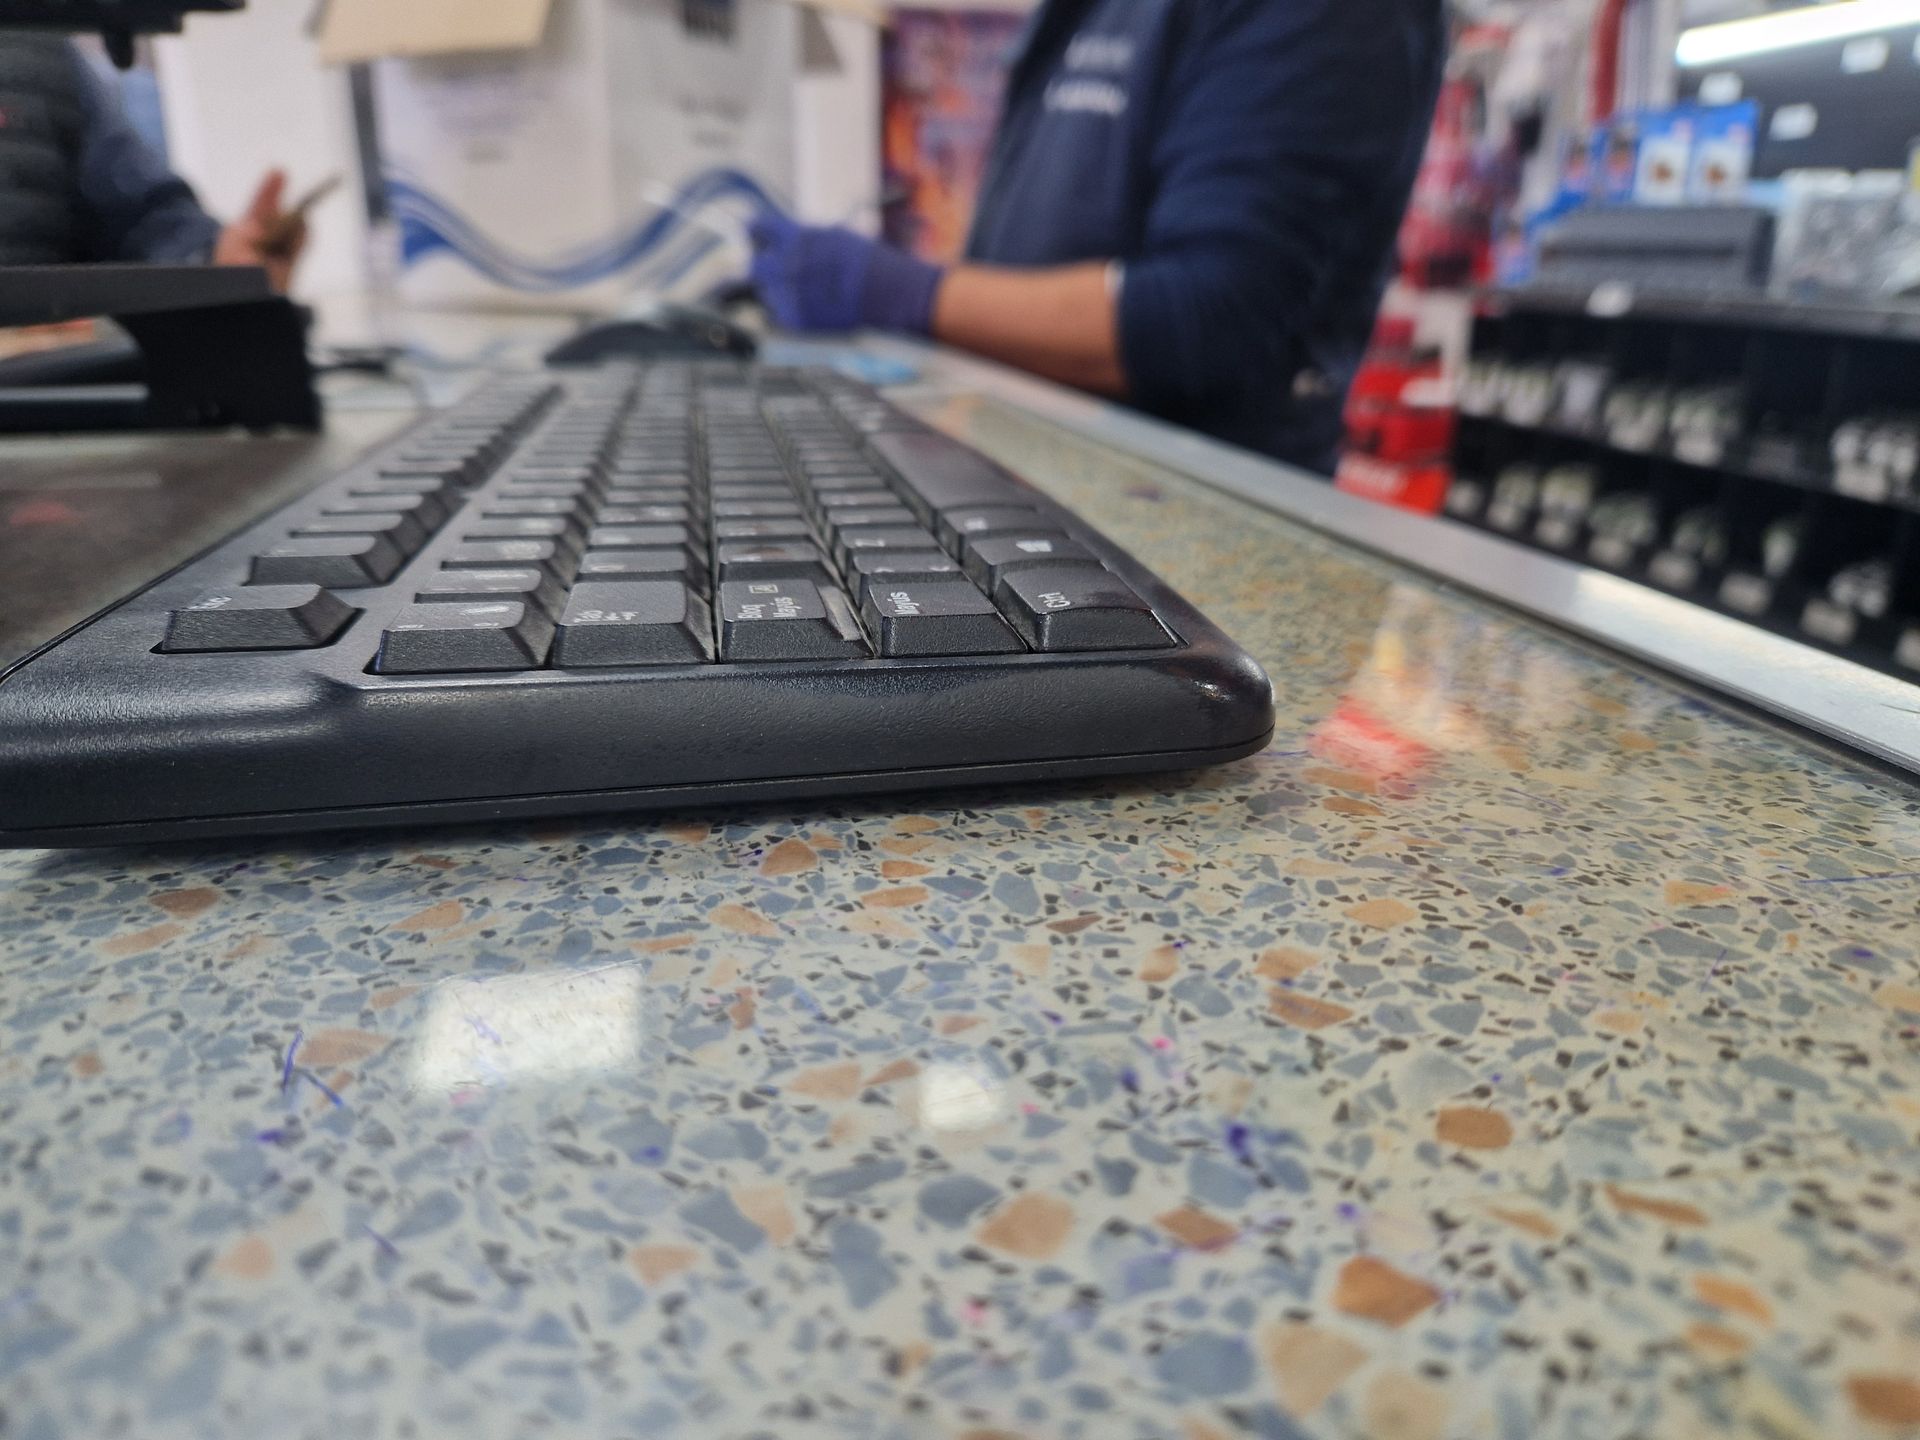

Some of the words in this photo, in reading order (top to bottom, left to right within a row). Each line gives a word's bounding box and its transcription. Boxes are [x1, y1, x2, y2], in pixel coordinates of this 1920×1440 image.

[769, 597, 802, 617] Mayús
[886, 591, 920, 615] Mayús
[1038, 592, 1071, 608] Ctrl
[737, 604, 766, 618] Bloq
